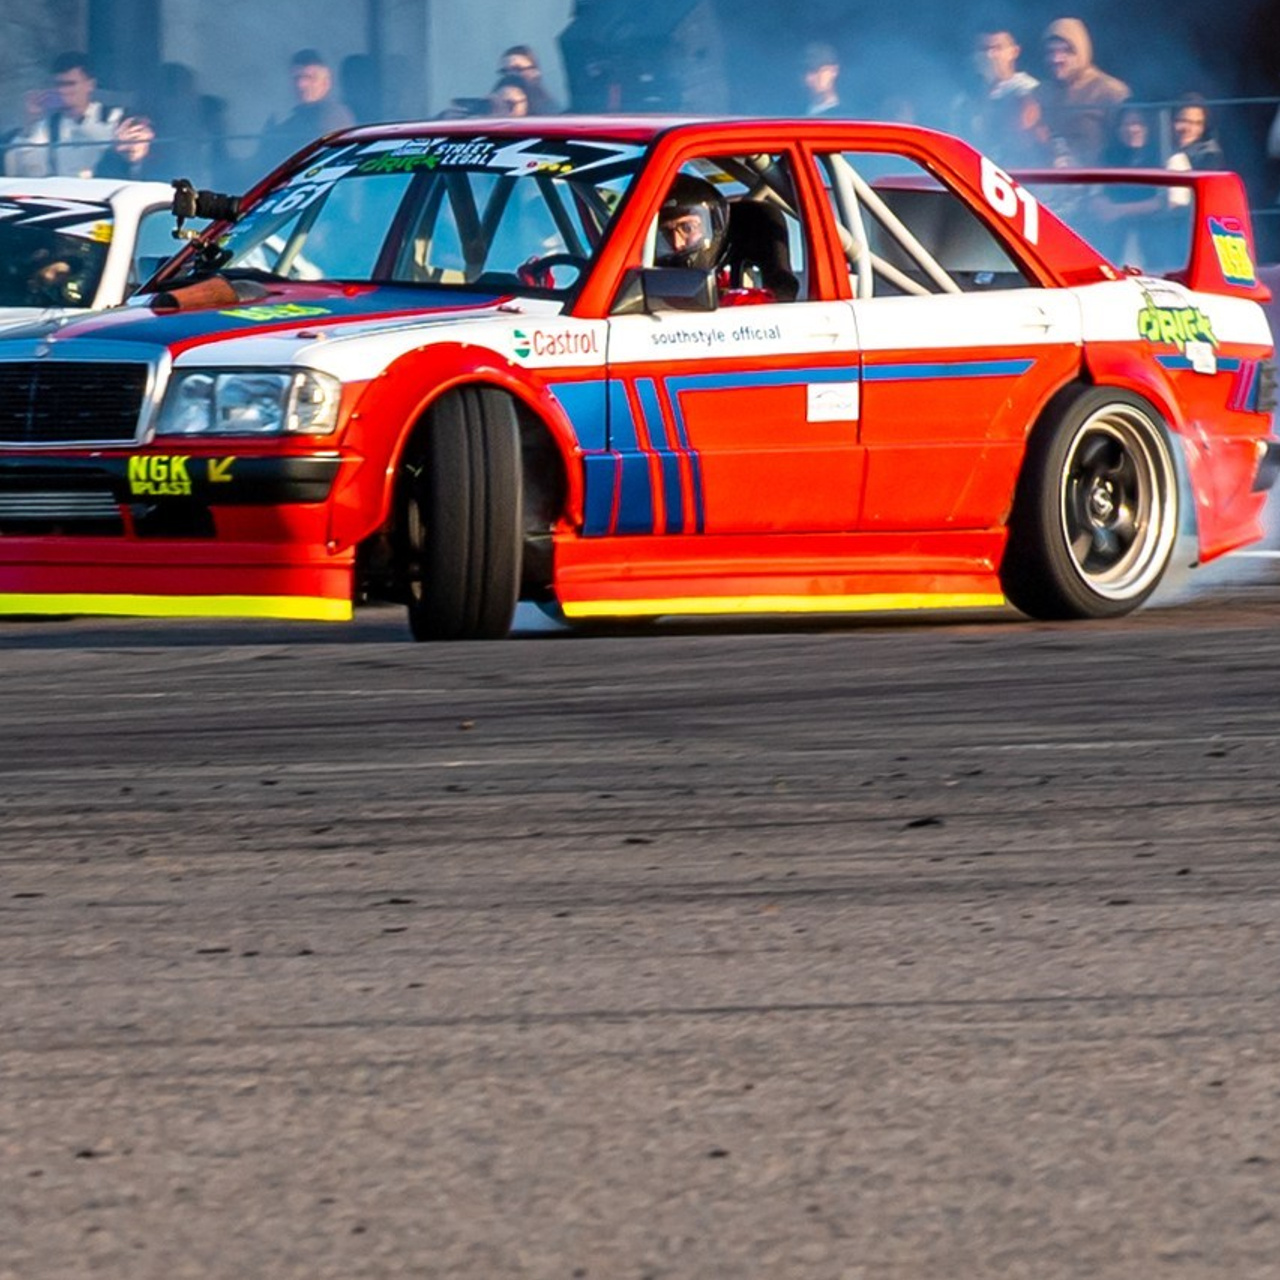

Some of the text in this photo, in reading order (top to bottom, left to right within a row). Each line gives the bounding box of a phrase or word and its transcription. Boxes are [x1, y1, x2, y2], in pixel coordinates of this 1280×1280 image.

[433, 143, 496, 154] STREET
[440, 154, 489, 165] LEGAL
[981, 157, 1038, 246] 61
[533, 329, 598, 356] Castrol
[651, 325, 782, 347] southstyle official
[128, 455, 192, 481] NGK
